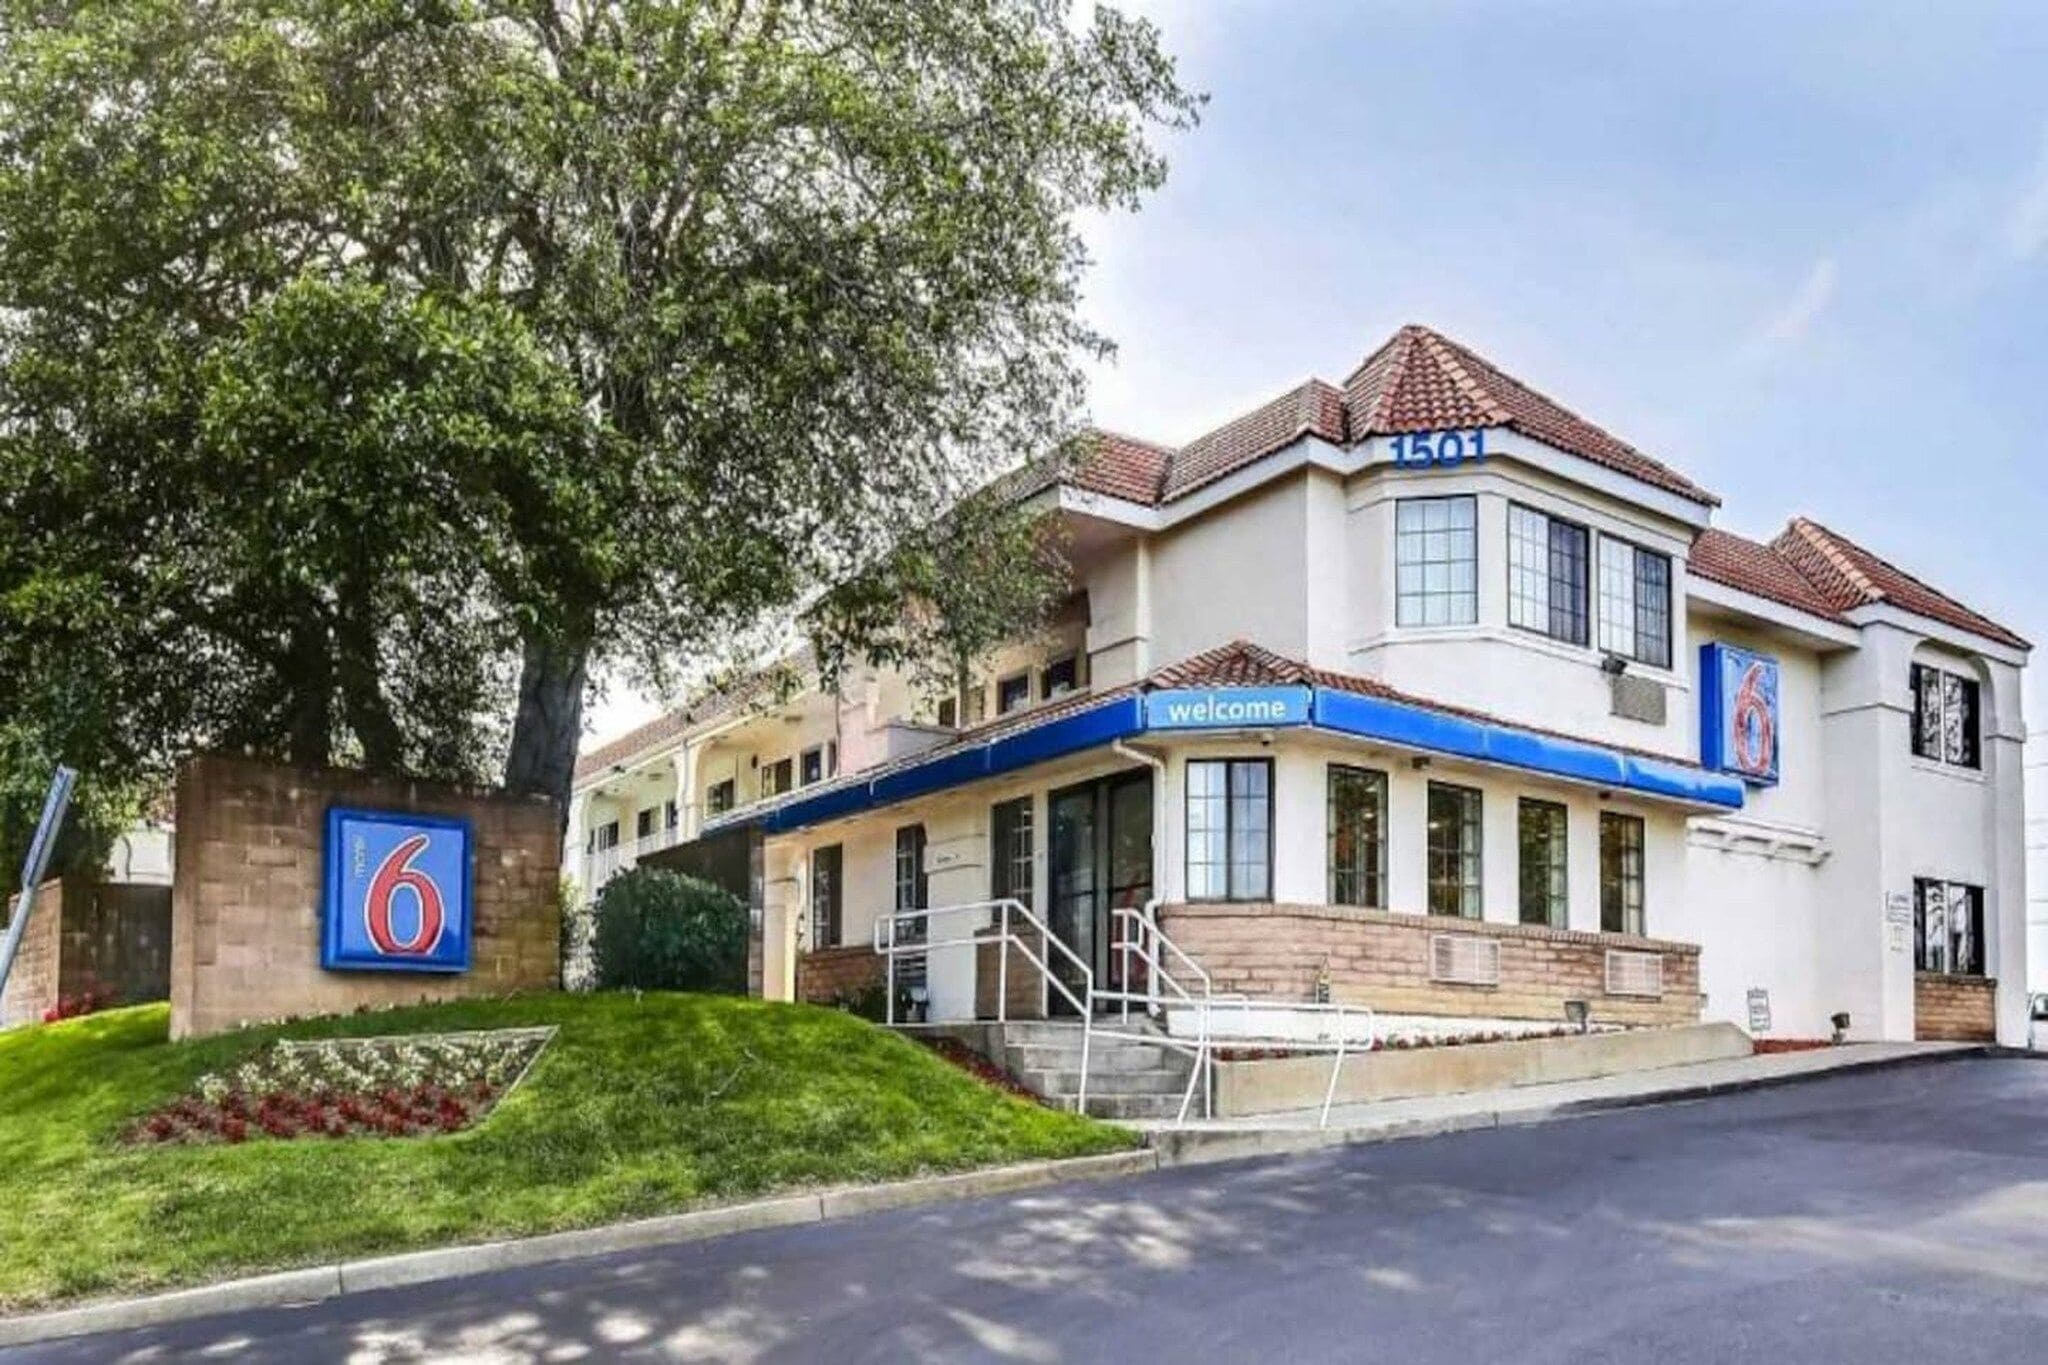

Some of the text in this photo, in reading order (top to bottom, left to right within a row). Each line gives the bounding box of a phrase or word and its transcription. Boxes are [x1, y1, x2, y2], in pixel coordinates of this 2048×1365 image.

[1390, 427, 1484, 470] 1501
[1168, 694, 1287, 722] welcome
[1734, 661, 1774, 775] 6
[364, 833, 445, 956] 6
